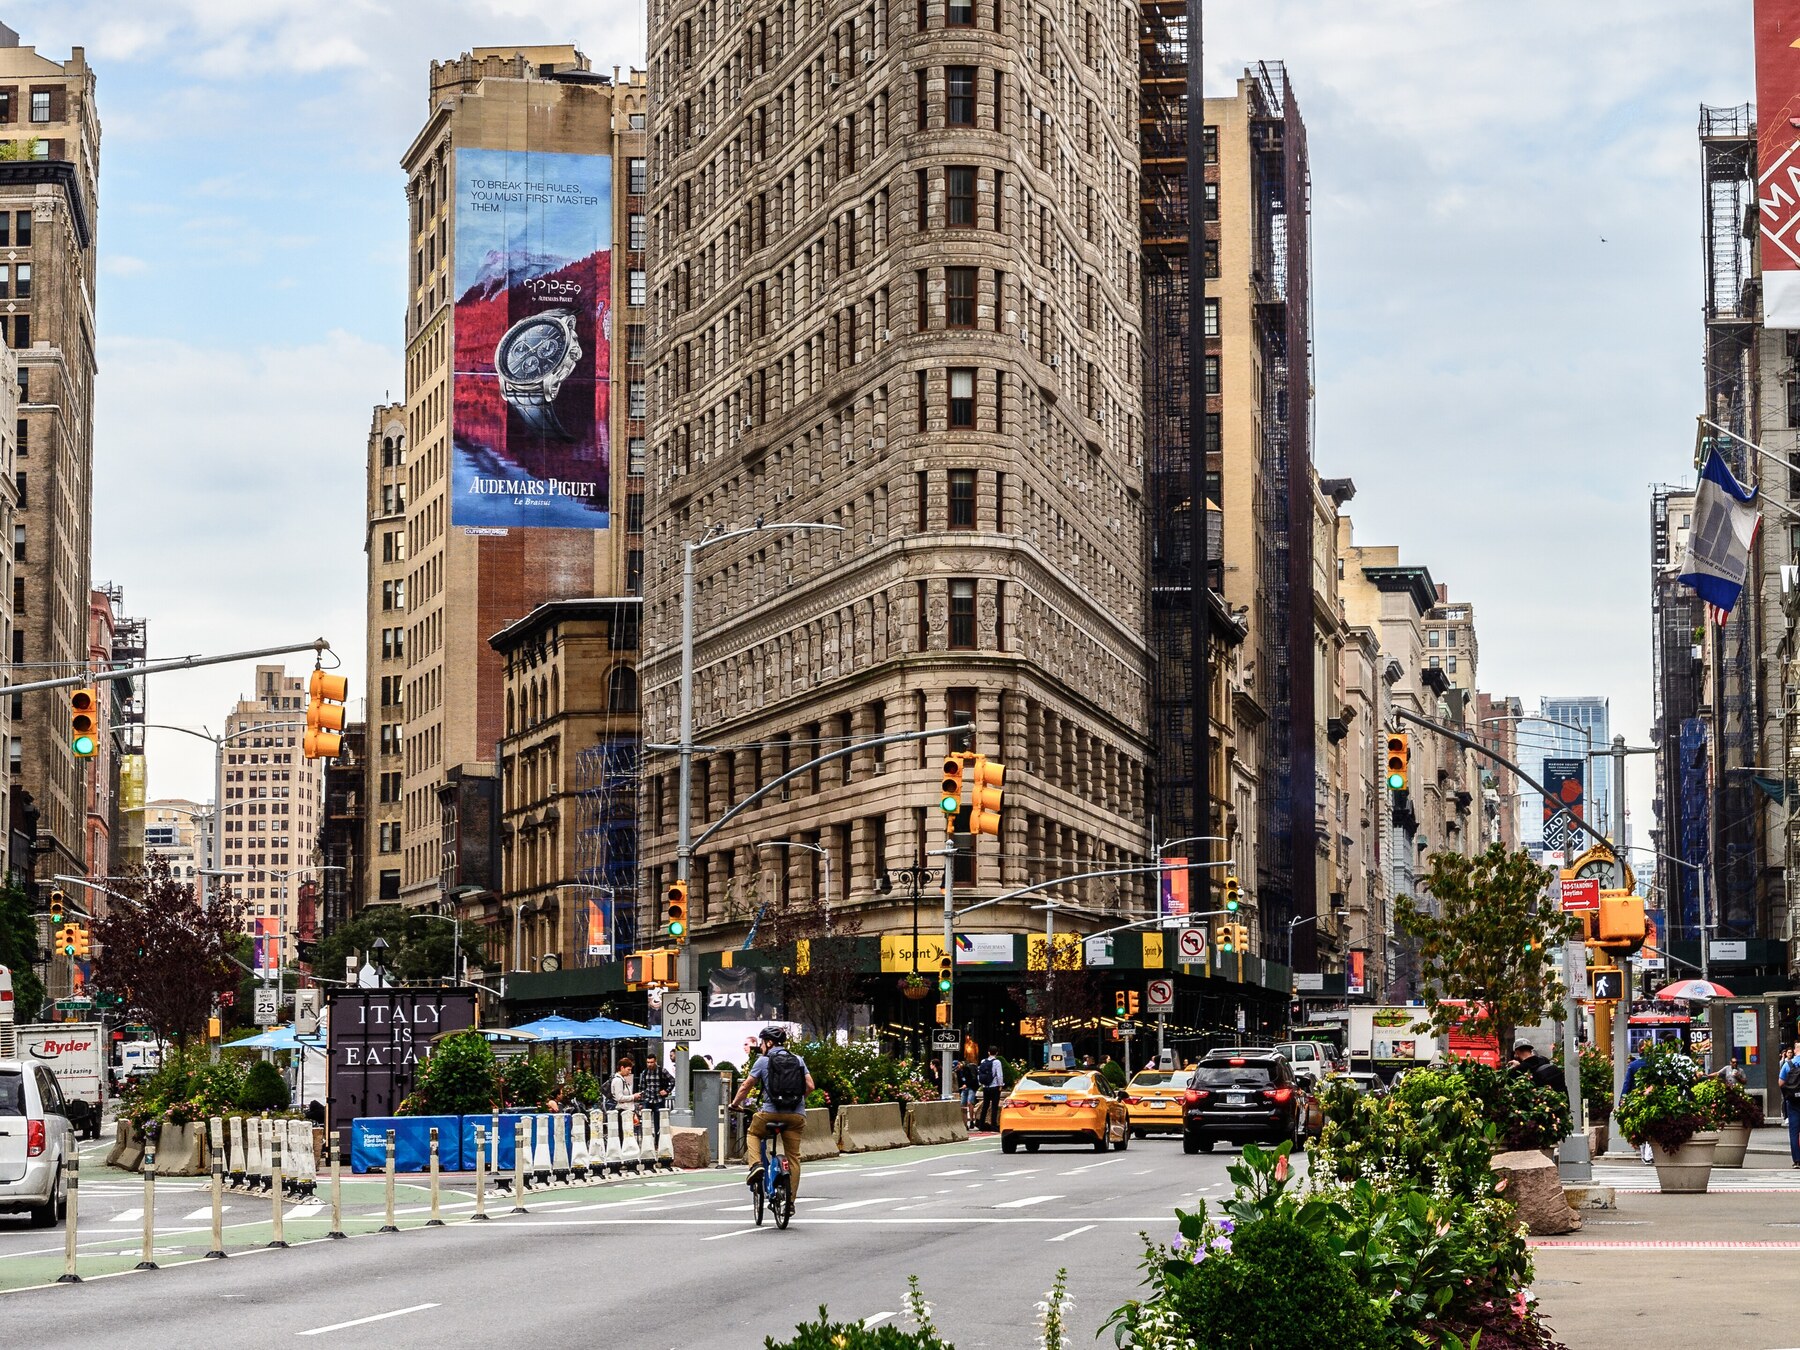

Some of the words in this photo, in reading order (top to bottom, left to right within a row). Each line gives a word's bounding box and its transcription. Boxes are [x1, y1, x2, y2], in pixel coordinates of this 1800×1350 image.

[471, 180, 486, 189] TO
[487, 181, 522, 190] BREAK
[524, 182, 544, 192] THE
[546, 184, 582, 194] RULES,
[471, 191, 493, 200] YOU
[495, 192, 524, 202] MUST
[526, 194, 554, 204] FIRST
[556, 196, 598, 206] MASTER
[471, 202, 502, 212] THEM.
[468, 476, 545, 496] AUDEMARS
[548, 478, 596, 497] PIGUET
[514, 498, 523, 506] Le
[524, 498, 552, 506] Brassus
[1714, 565, 1741, 582] COMPANY
[1544, 817, 1563, 838] MAD
[1144, 946, 1157, 958] Sprint
[258, 1003, 275, 1013] 25
[358, 1005, 447, 1024] ITALY
[670, 1019, 693, 1027] LANE
[393, 1028, 412, 1042] IS
[44, 1040, 91, 1054] Ryder
